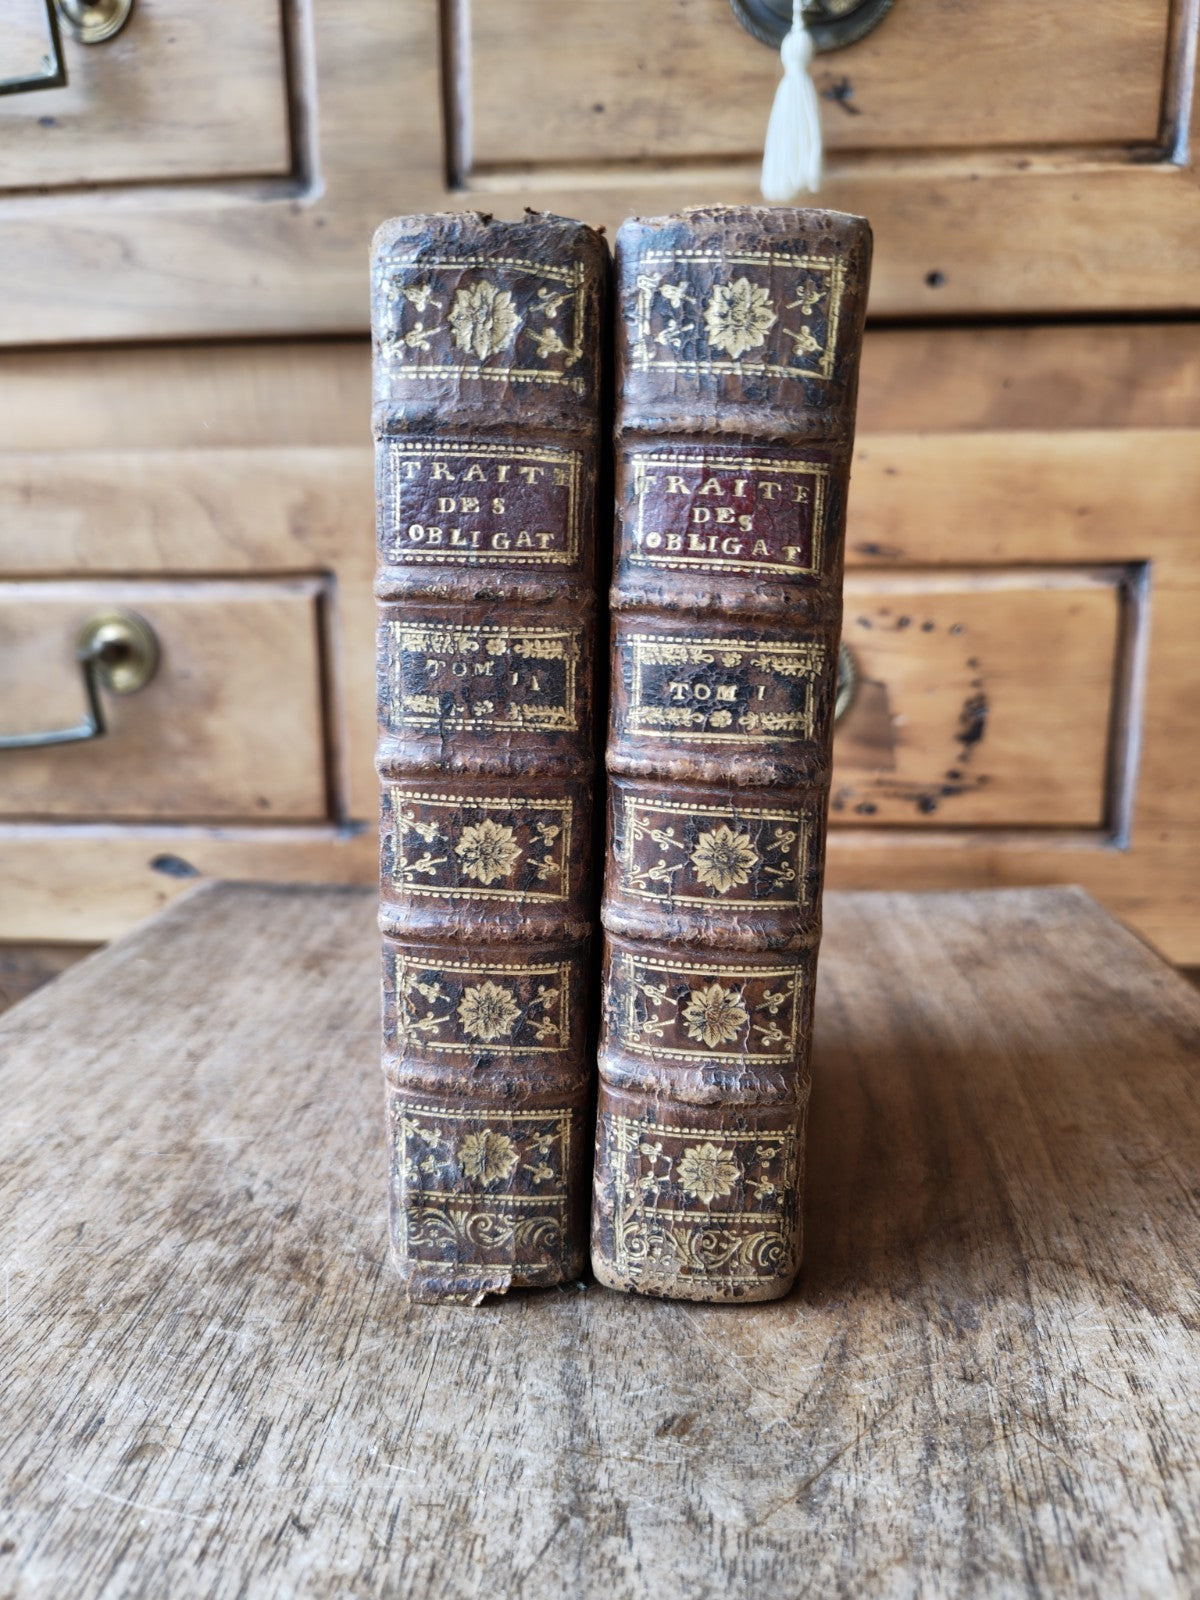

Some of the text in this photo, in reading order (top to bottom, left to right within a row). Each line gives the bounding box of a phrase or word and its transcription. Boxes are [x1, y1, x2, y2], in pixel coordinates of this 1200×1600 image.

[438, 497, 506, 515] DES
[692, 507, 753, 532] DES
[408, 523, 555, 550] OBLIGAT
[645, 531, 801, 563] OBLIGAT
[669, 681, 739, 702] TOM
